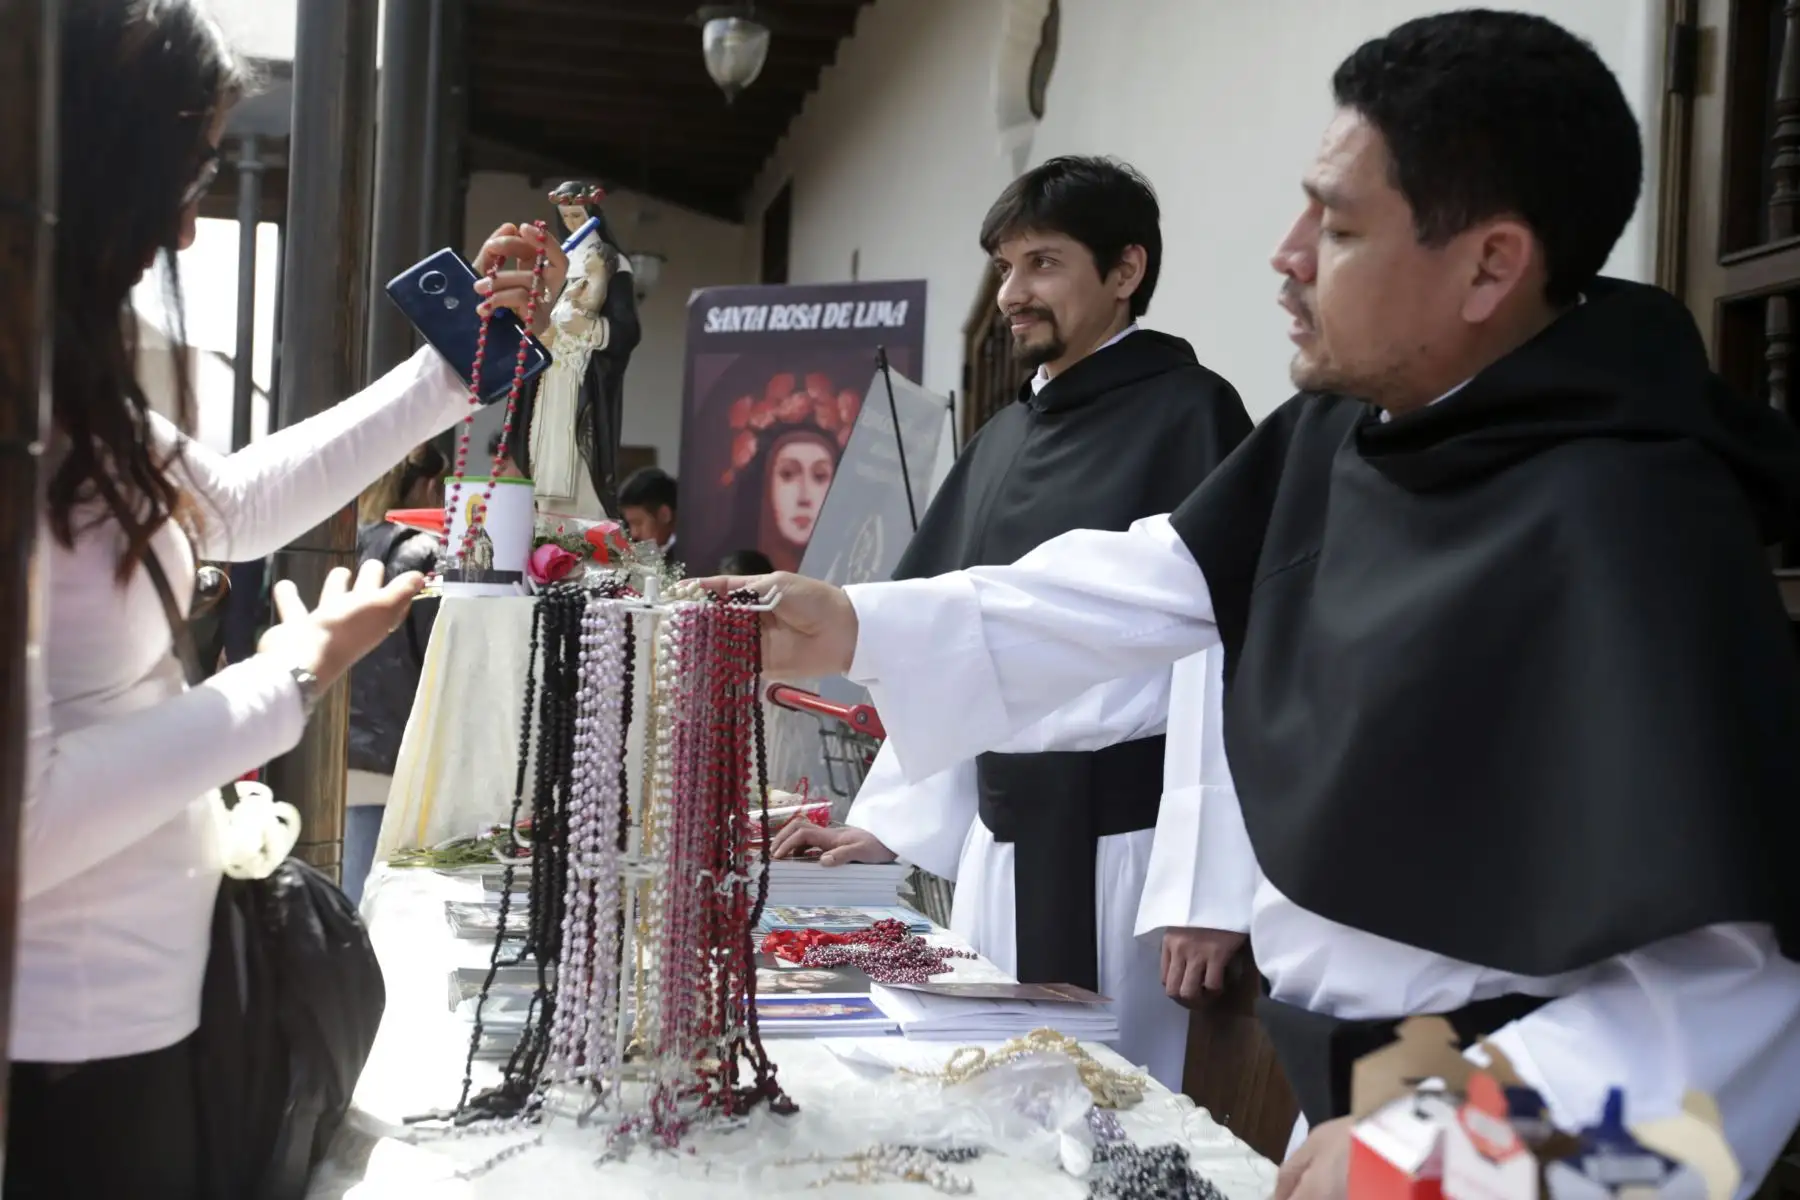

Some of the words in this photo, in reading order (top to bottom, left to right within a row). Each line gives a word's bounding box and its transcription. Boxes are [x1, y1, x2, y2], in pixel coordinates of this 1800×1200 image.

[704, 305, 768, 333] SANTA
[768, 303, 822, 331] ROSA
[822, 302, 854, 329] DE
[853, 300, 908, 328] LIMA
